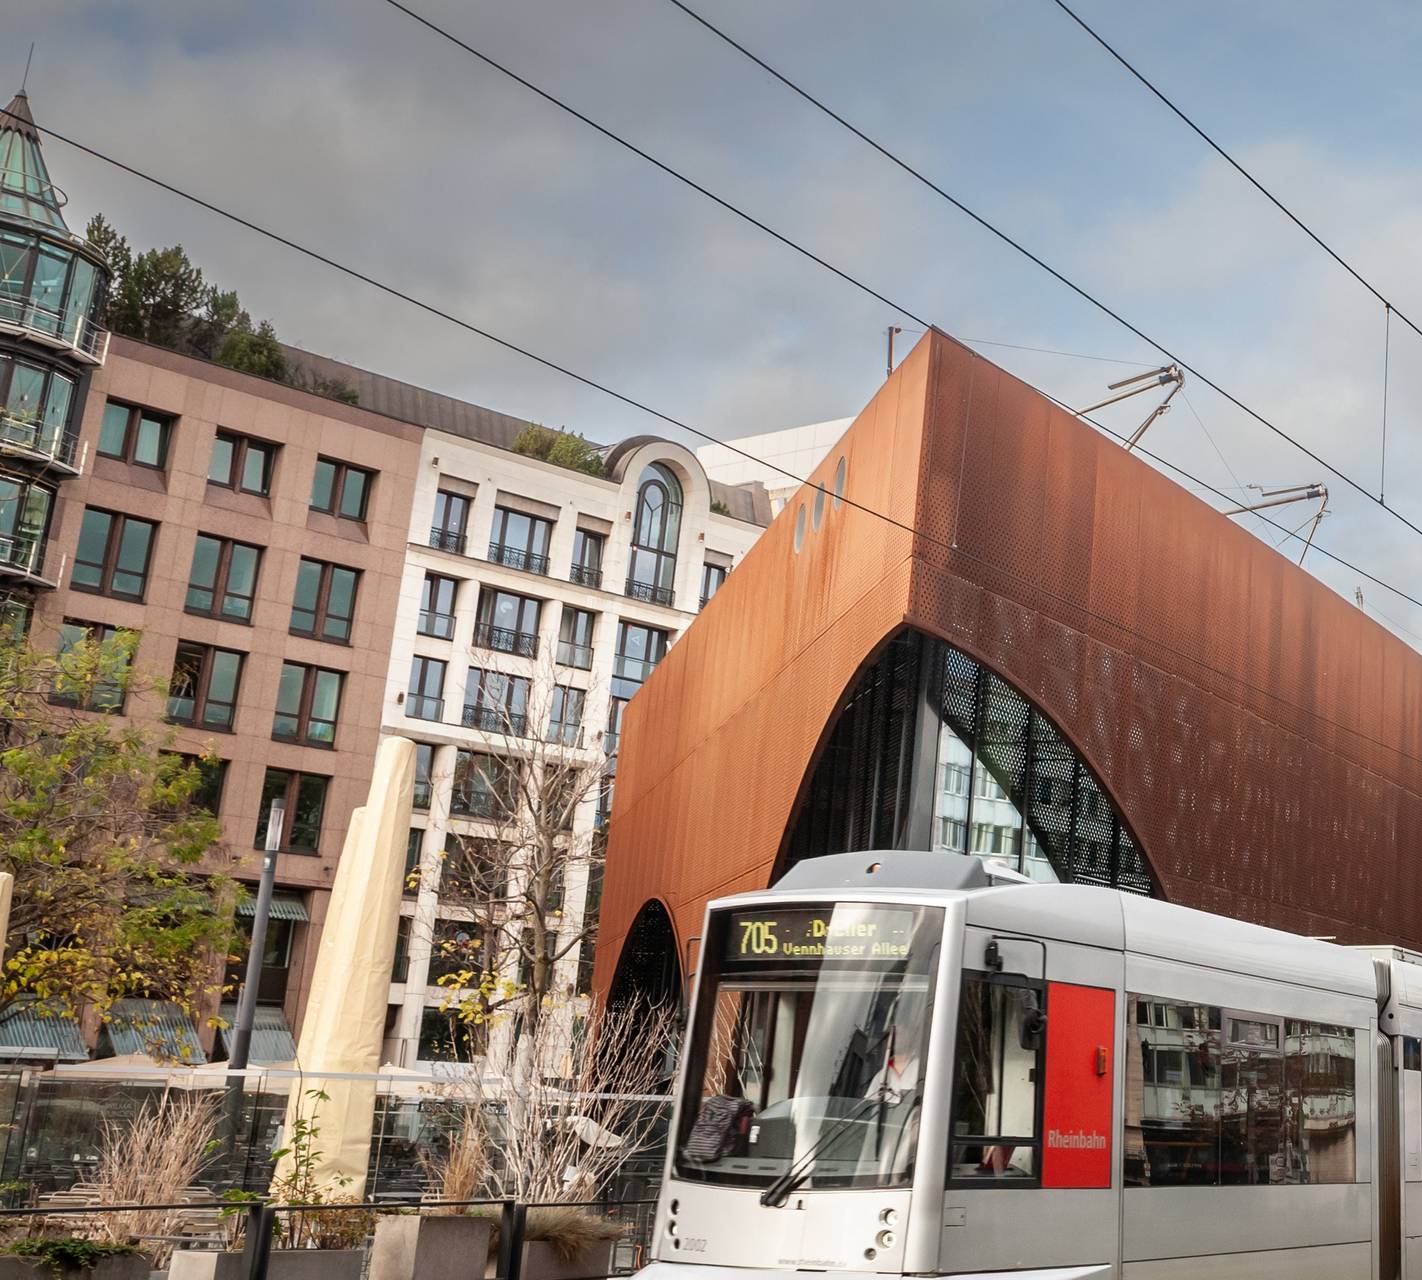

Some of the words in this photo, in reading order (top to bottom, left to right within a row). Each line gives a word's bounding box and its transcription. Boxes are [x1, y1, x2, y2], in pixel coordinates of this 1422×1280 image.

[739, 922, 778, 954] 705
[871, 941, 909, 955] Allee
[1048, 1129, 1107, 1149] Rheinbahn
